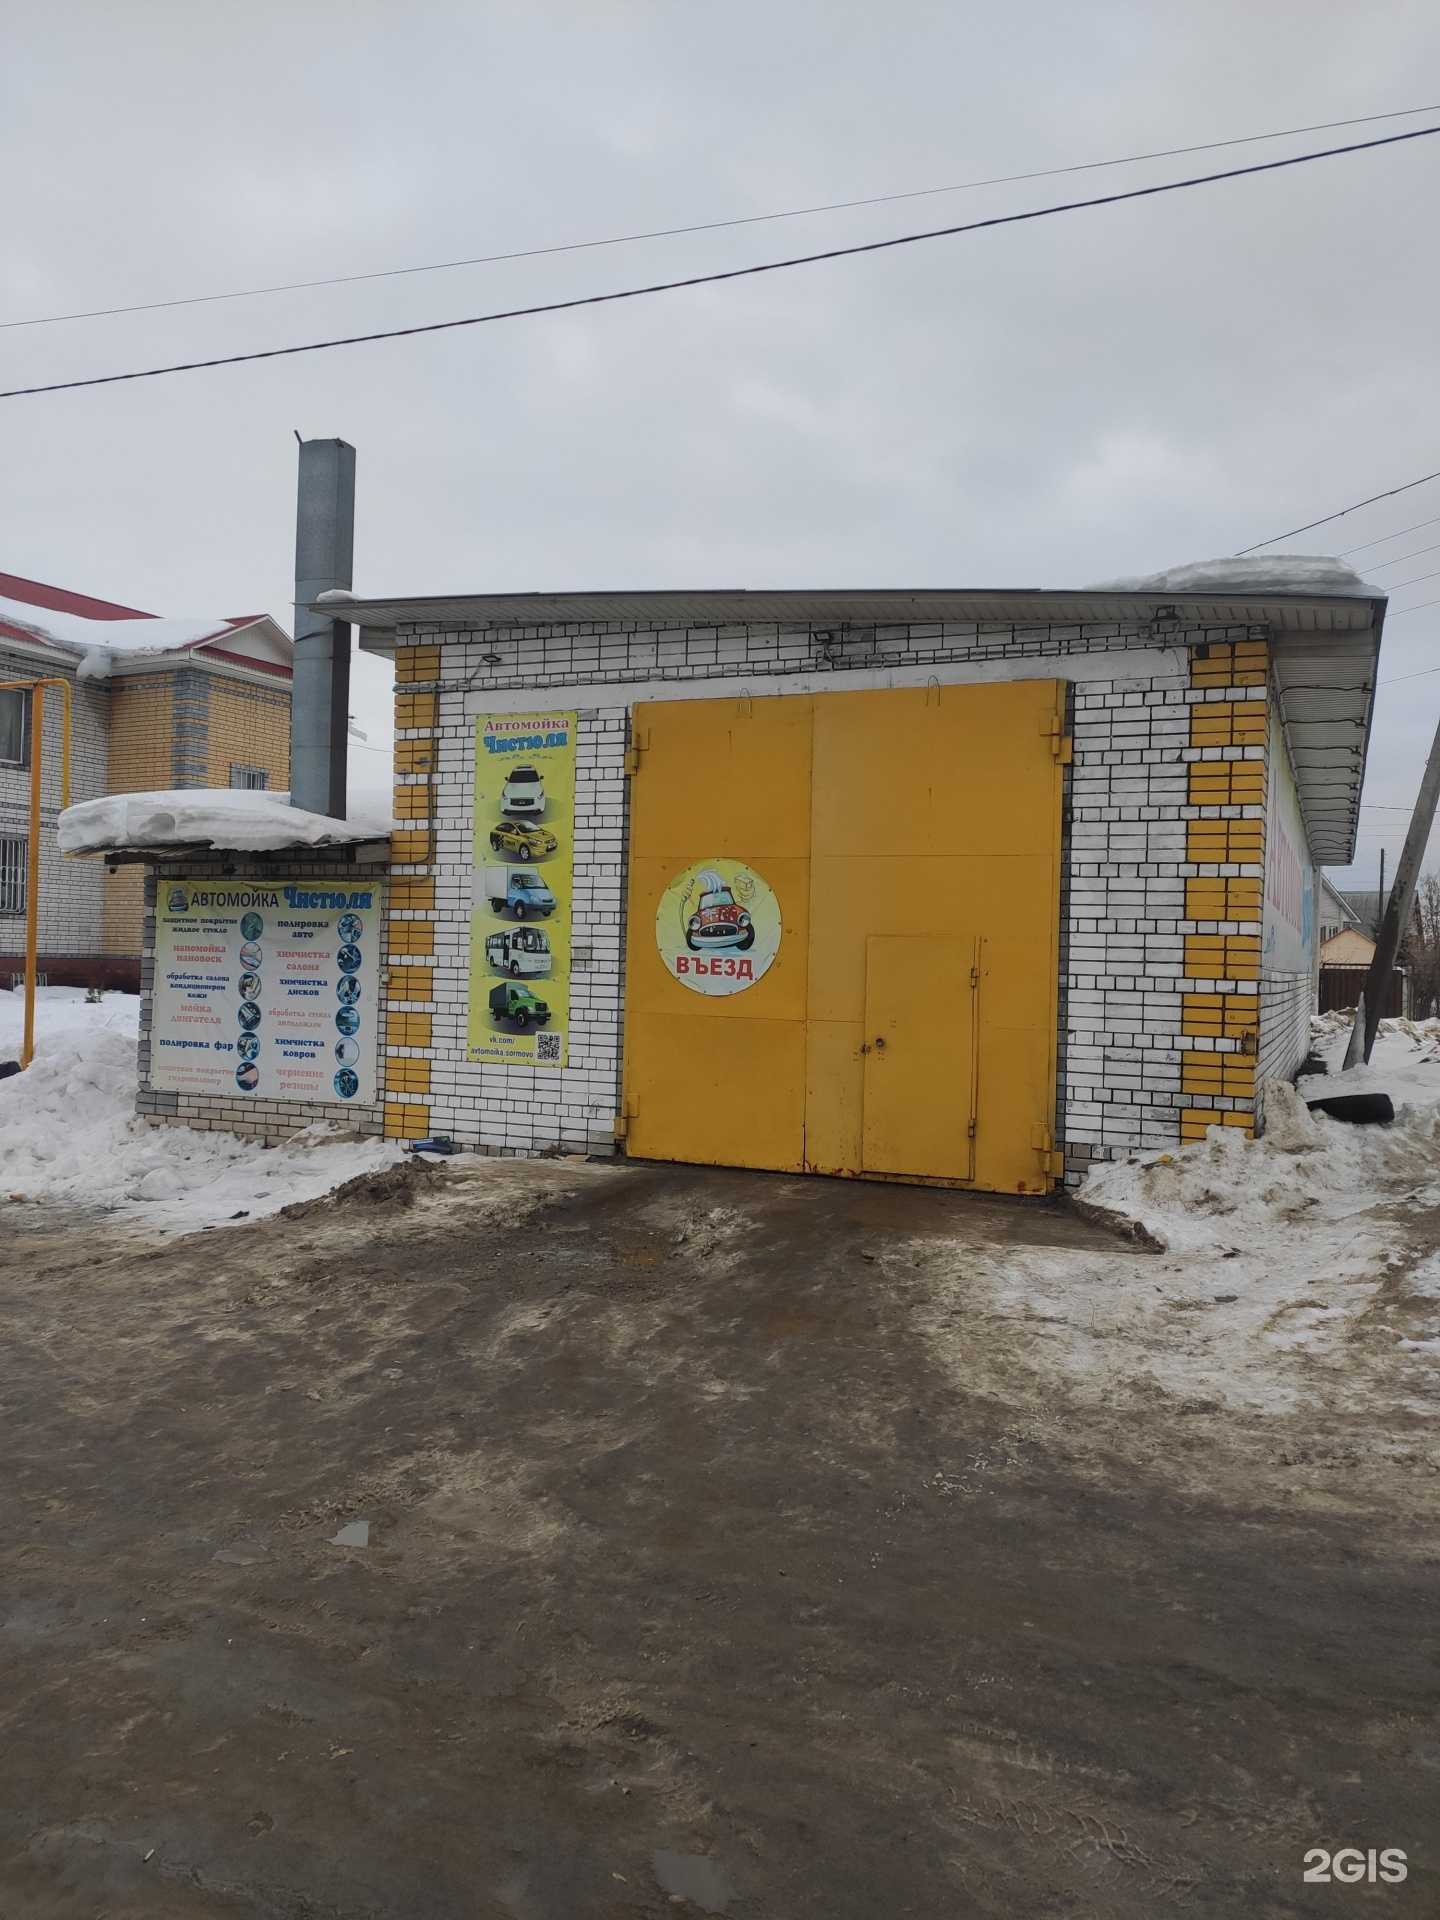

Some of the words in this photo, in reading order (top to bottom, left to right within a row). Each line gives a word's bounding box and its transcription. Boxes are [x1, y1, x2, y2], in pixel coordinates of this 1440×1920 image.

[484, 719, 569, 731] Автомойка
[484, 732, 567, 754] Чистюля
[191, 888, 279, 908] АВТОМОЙКА
[284, 887, 373, 909] Чистюля
[277, 920, 329, 930] полировка
[292, 930, 314, 938] авто
[276, 950, 330, 960] химчистка
[286, 962, 320, 971] салона
[676, 956, 754, 980] ВЪЕЗД
[166, 973, 203, 983] обработка
[279, 978, 328, 988] химчистка
[288, 988, 320, 997] дисков
[171, 1014, 222, 1025] двигателя
[160, 1039, 210, 1050] полировка
[214, 1040, 234, 1051] фар
[275, 1038, 325, 1048] химчистка
[283, 1049, 316, 1059] ковров
[276, 1068, 324, 1079] чернение
[280, 1080, 319, 1091] резины
